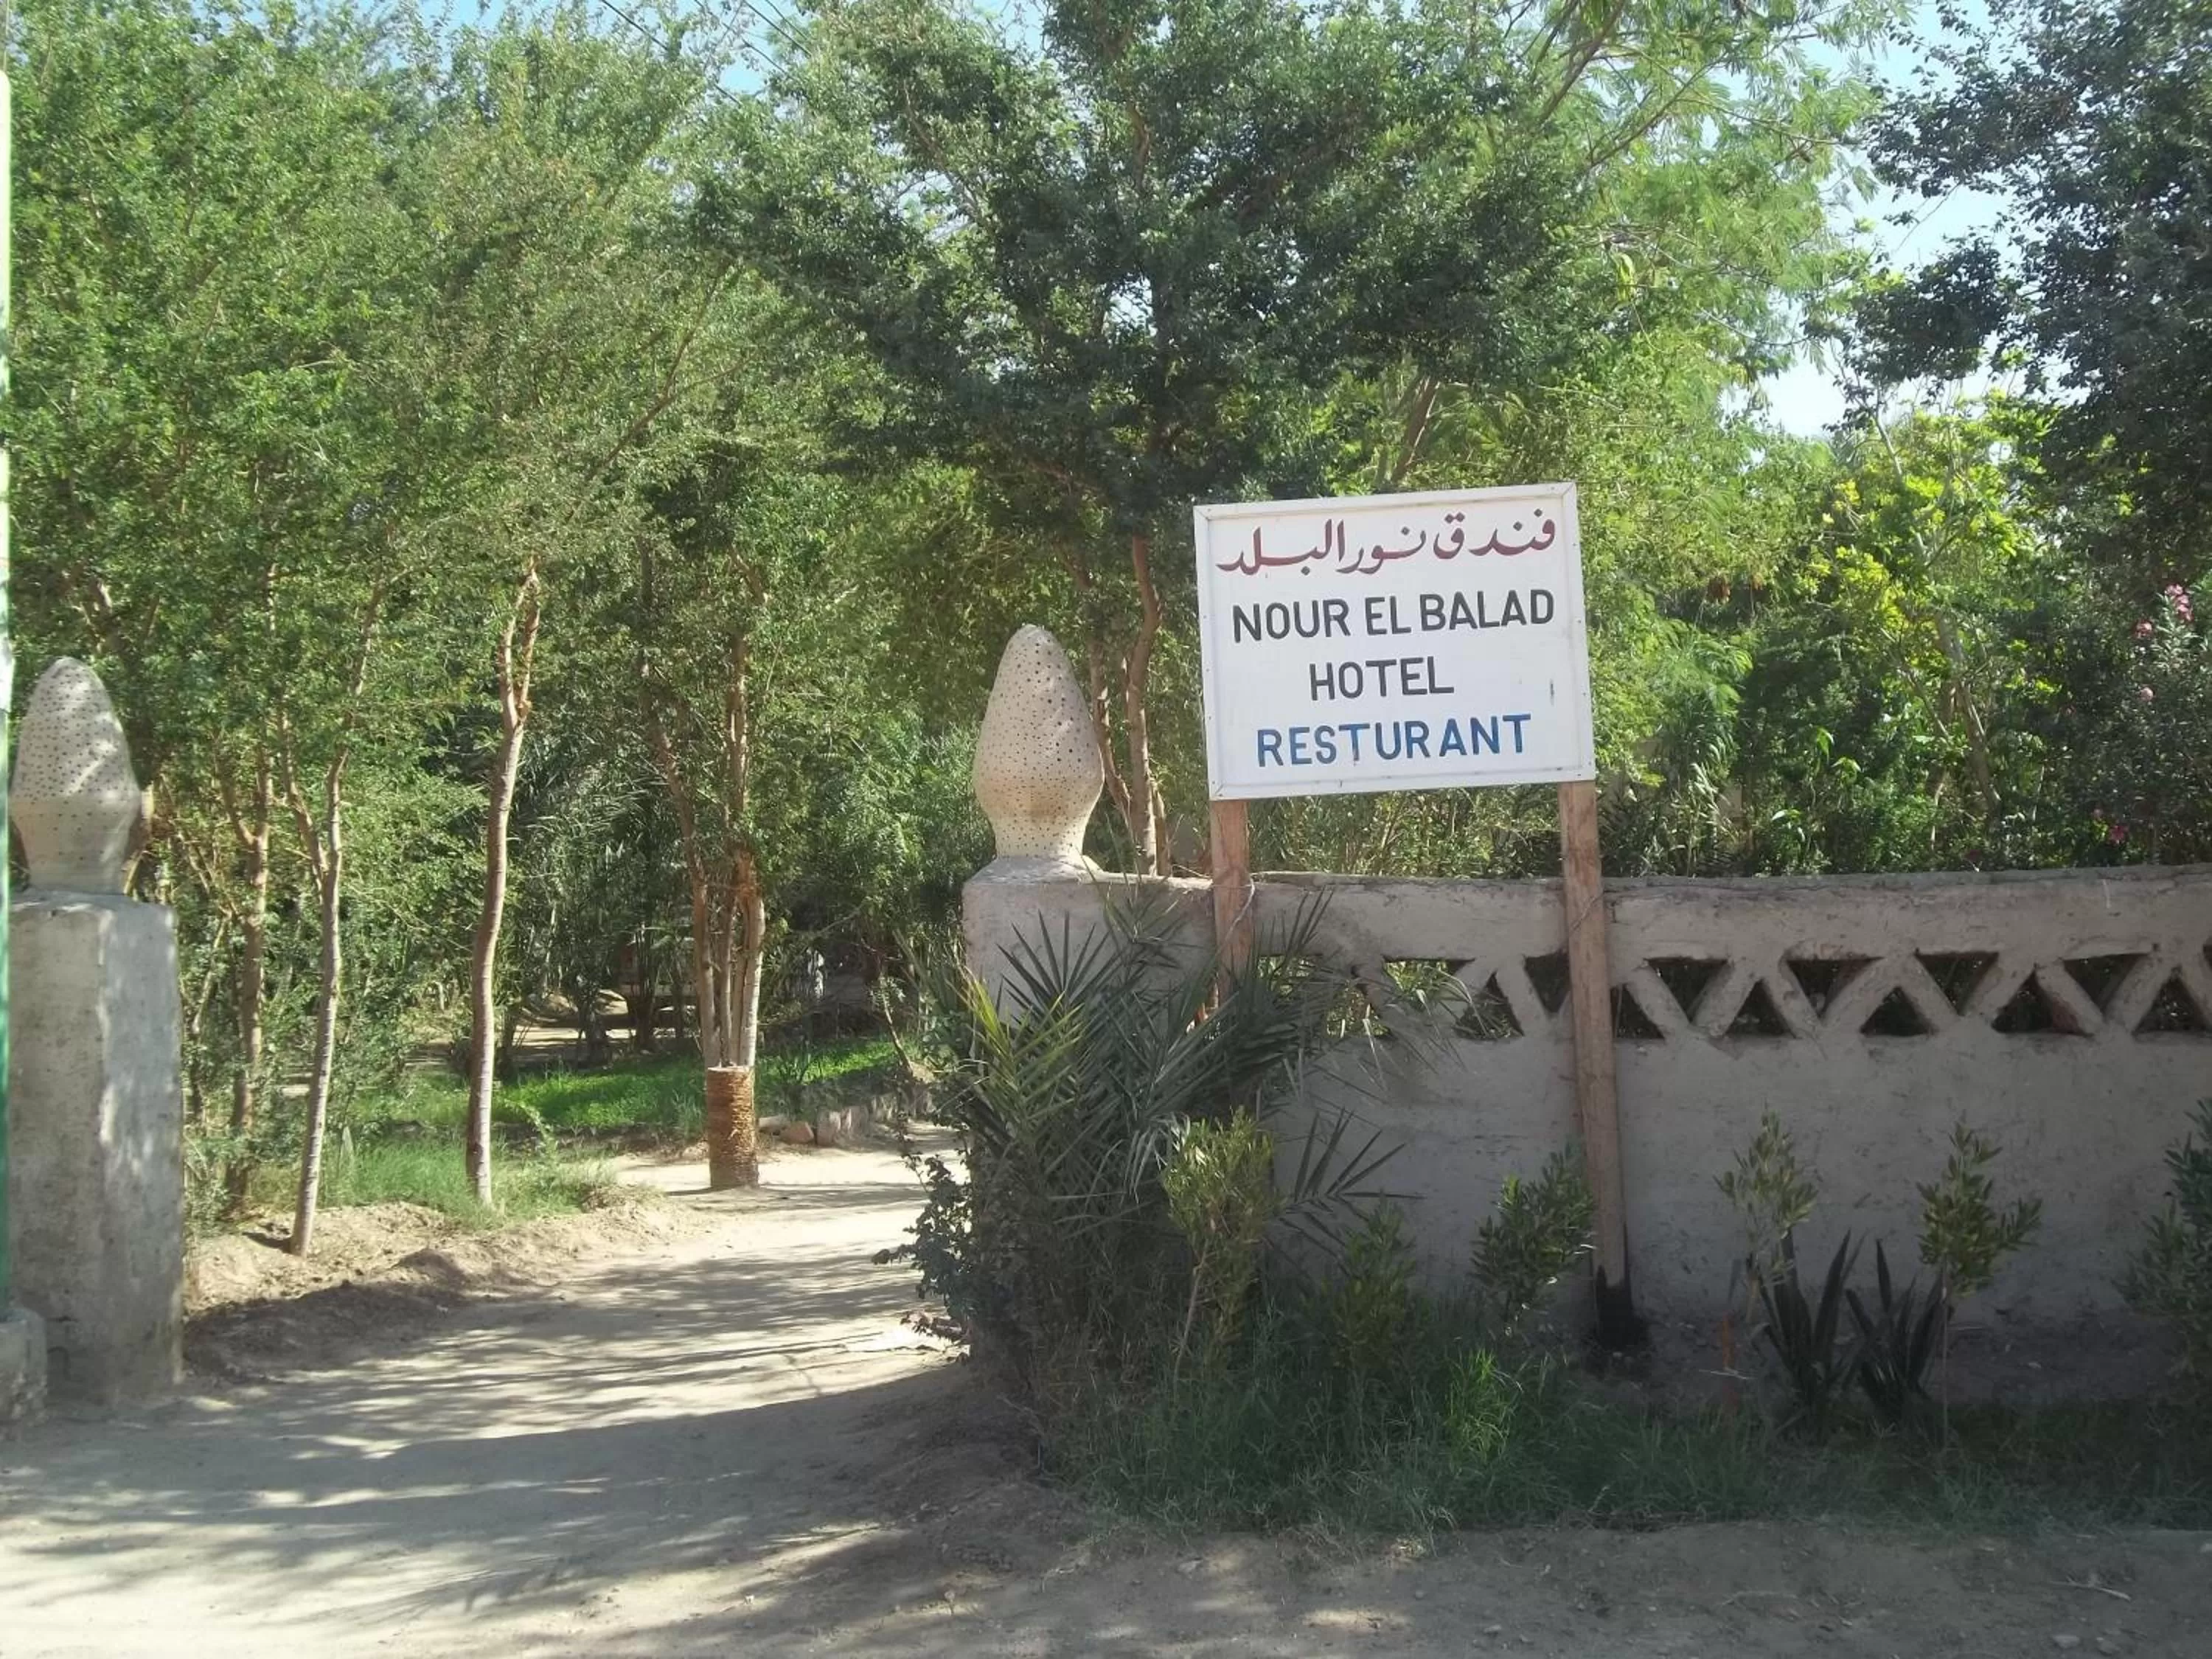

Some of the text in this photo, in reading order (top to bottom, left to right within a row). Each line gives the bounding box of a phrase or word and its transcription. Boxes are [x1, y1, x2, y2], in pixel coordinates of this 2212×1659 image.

[1216, 508, 1556, 577] فندق نور البلد
[1232, 589, 1555, 644] NOUR EL BALAD
[1308, 655, 1455, 701] HOTEL
[1256, 713, 1532, 768] RESTURANT
